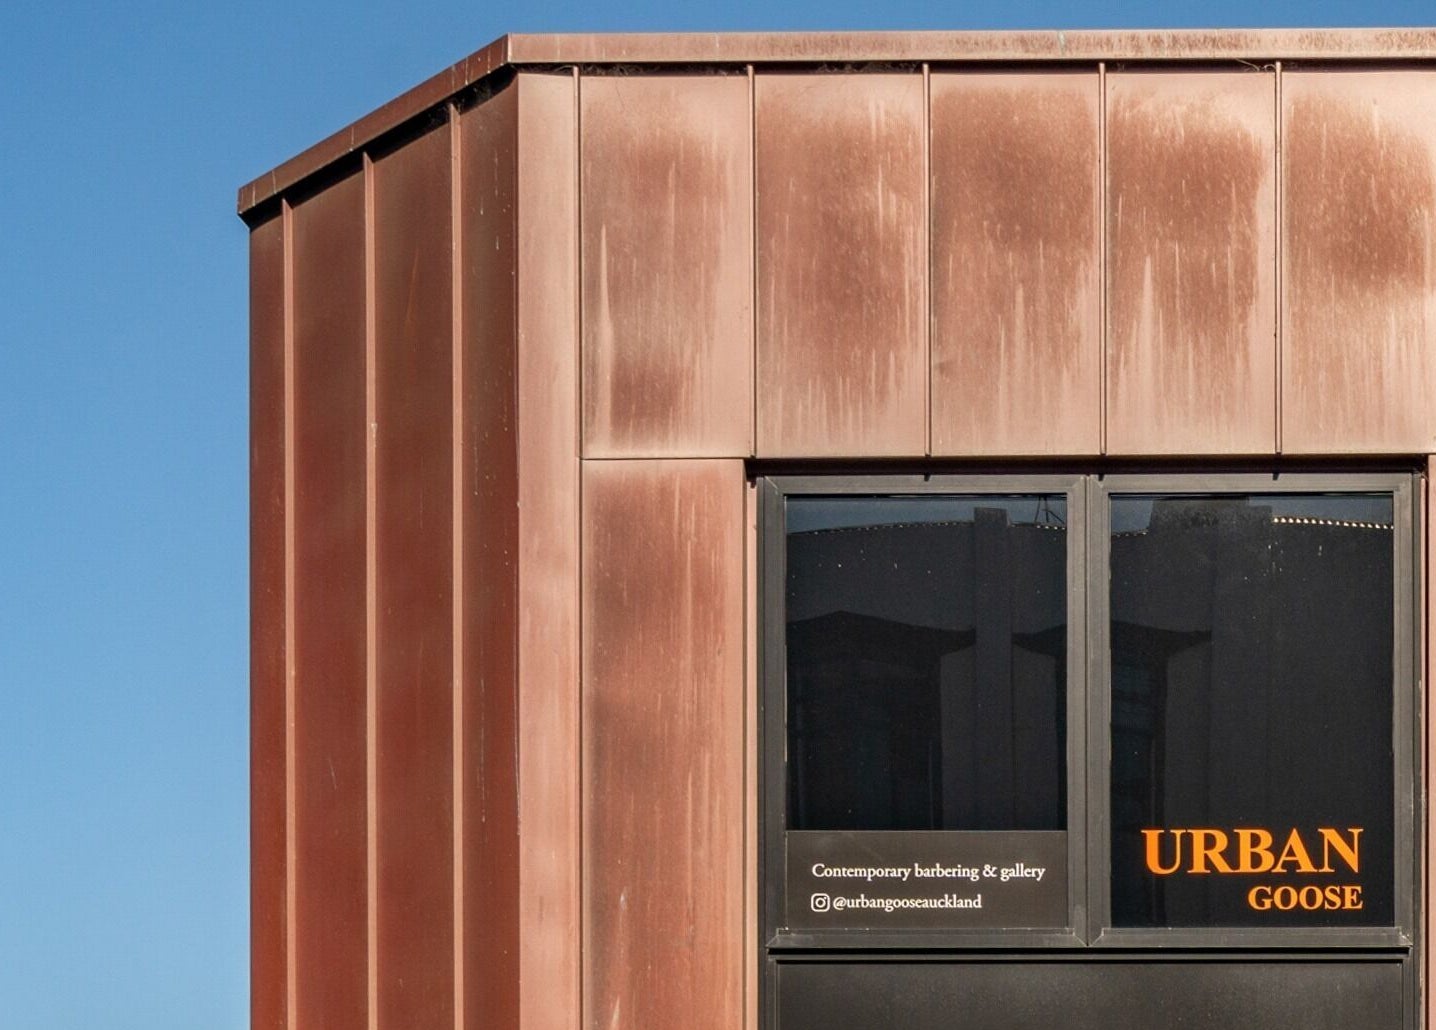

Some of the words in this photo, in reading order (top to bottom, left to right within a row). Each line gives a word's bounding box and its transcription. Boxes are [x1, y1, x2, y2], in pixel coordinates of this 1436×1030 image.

[1141, 828, 1364, 874] URBAN
[812, 863, 911, 881] Contemporary
[914, 863, 980, 881] barbering
[982, 864, 998, 877] &
[1000, 863, 1046, 881] gallery
[833, 894, 982, 912] @urbangooseauckland
[1248, 886, 1364, 910] GOOSE
